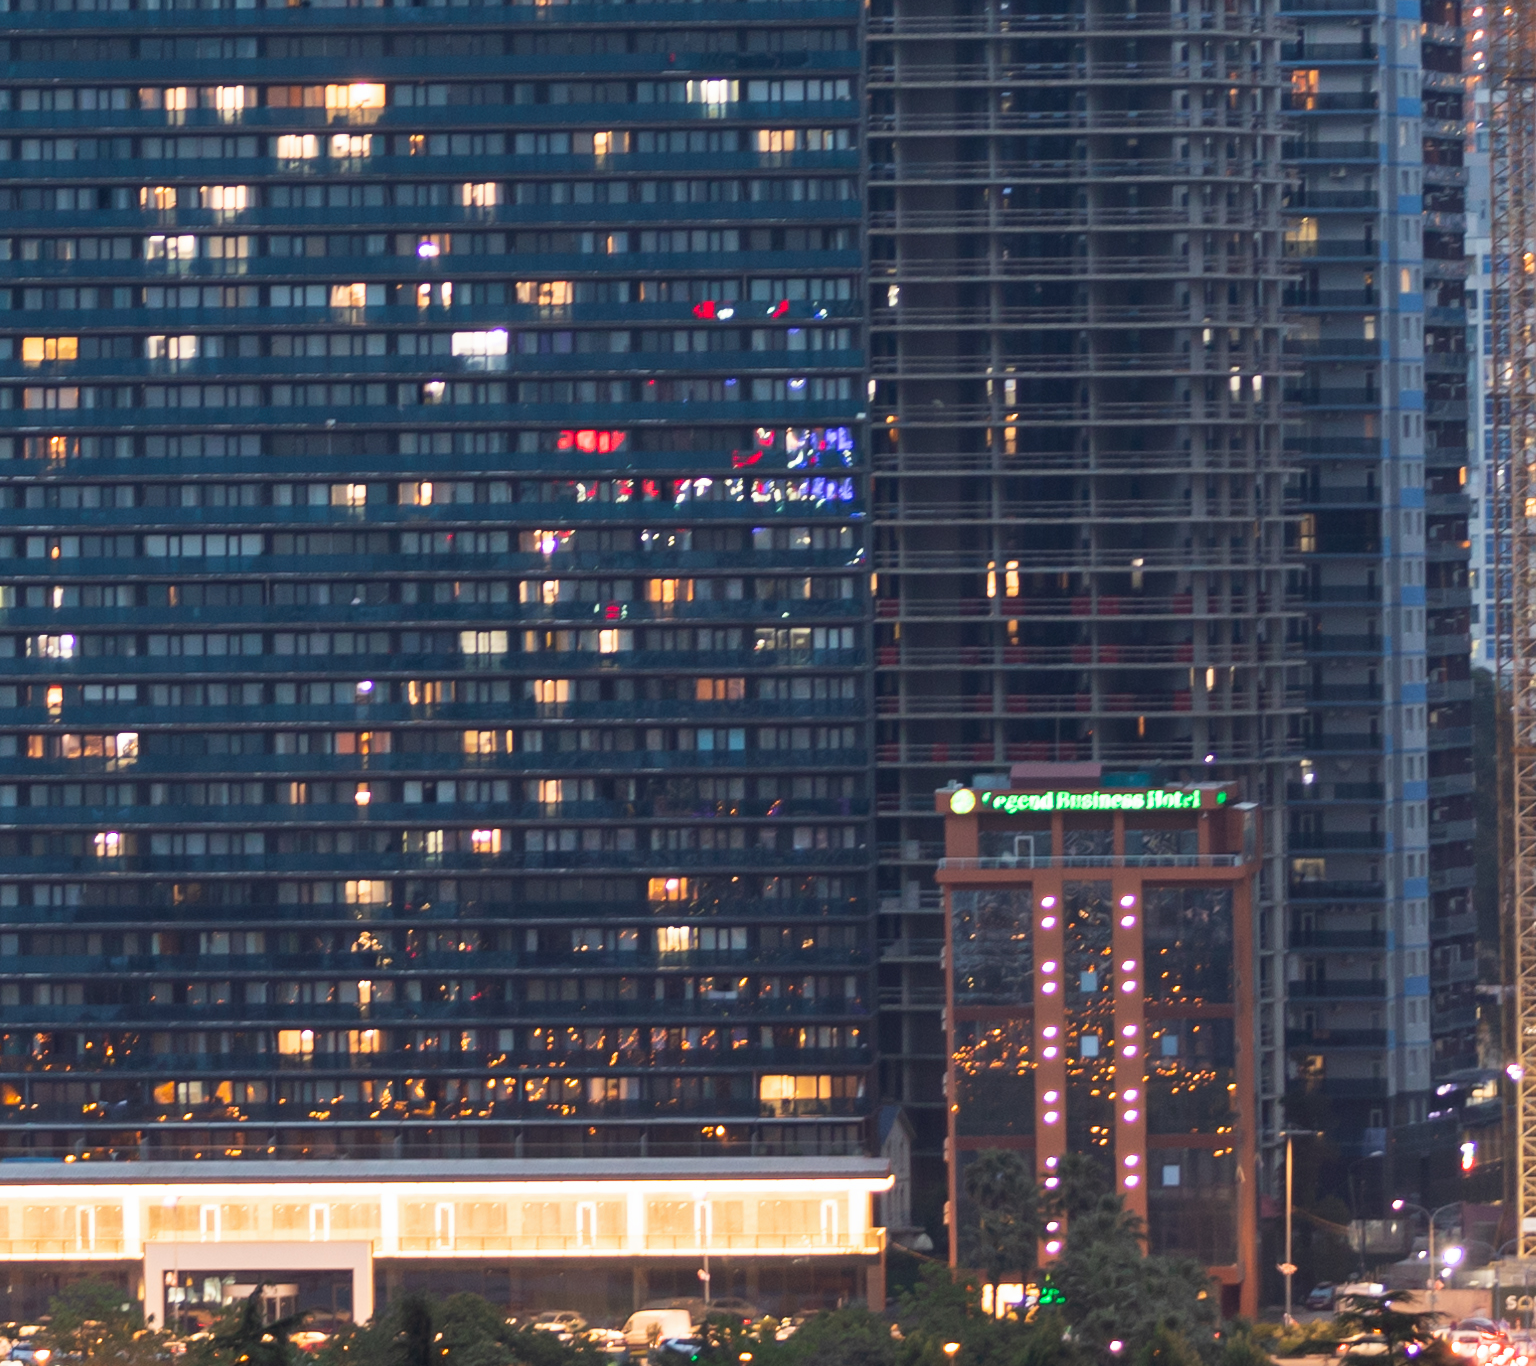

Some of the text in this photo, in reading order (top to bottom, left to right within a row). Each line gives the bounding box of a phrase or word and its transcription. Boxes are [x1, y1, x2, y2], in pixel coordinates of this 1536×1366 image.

[981, 788, 1202, 814] egend Business Hotel
